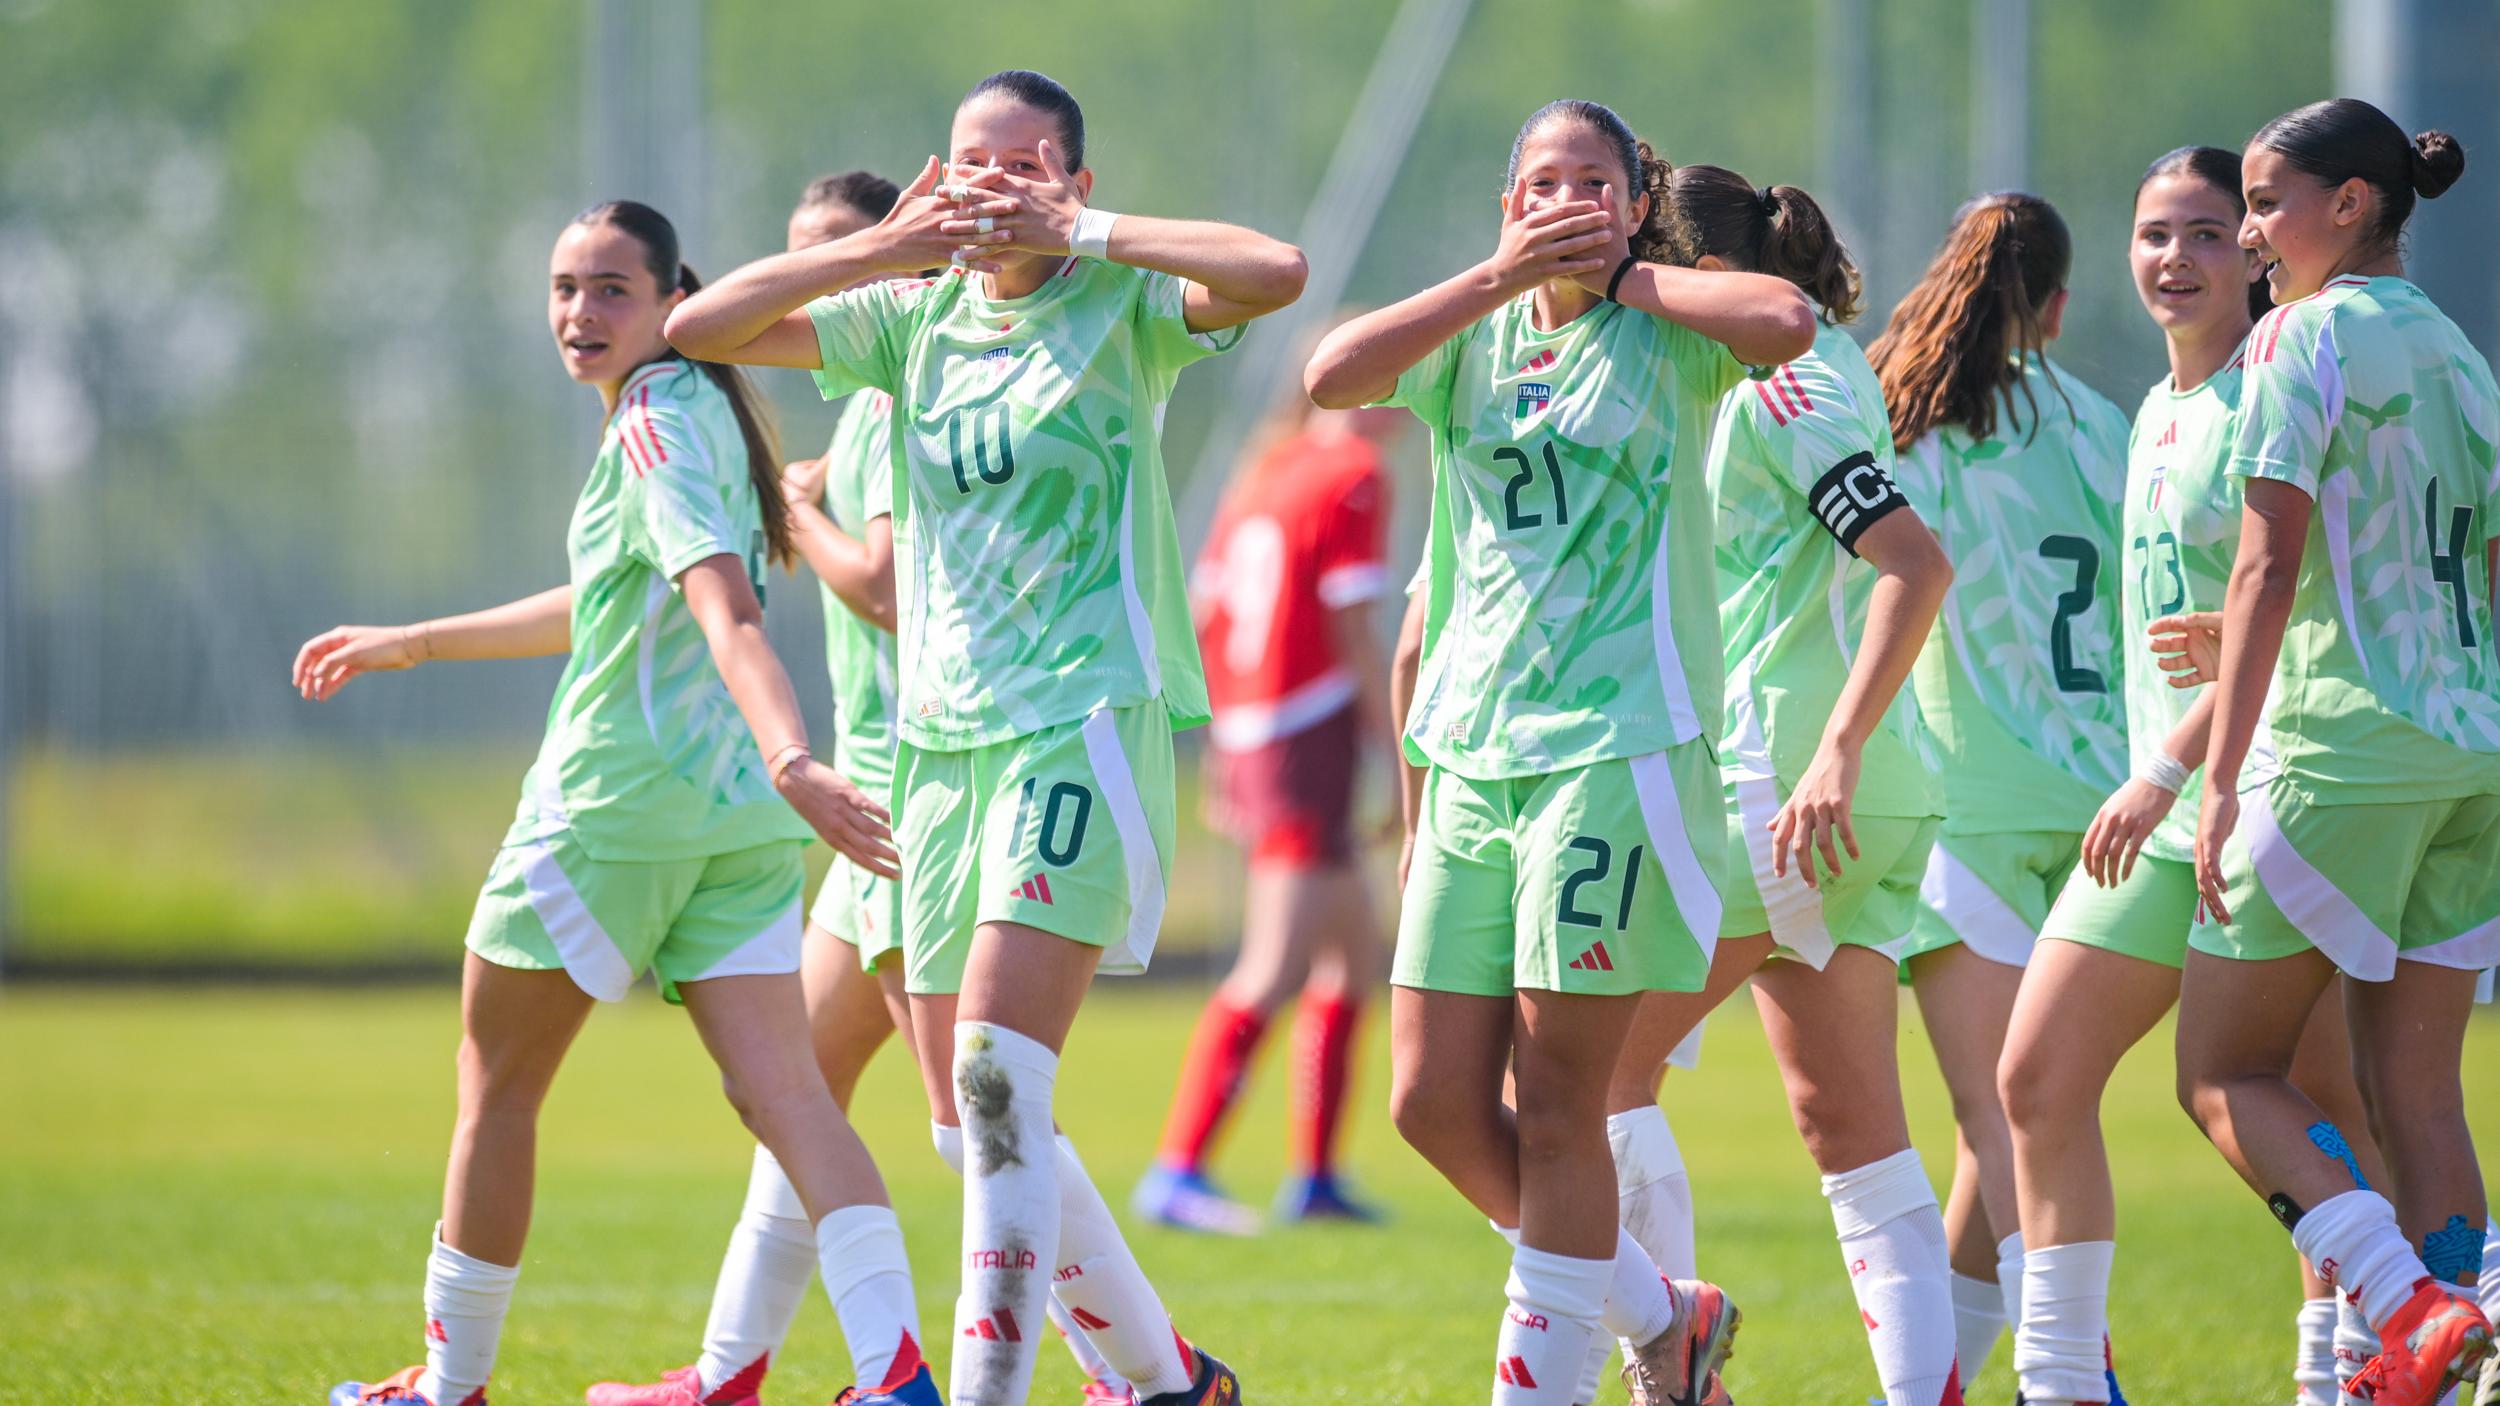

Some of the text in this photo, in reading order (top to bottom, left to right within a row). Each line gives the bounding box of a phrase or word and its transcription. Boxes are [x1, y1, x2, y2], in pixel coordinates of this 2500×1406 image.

[1518, 385, 1549, 397] ITALIA
[949, 400, 1015, 495] 10
[1493, 440, 1569, 531] 21
[1844, 465, 1889, 510] C
[2425, 475, 2477, 648] 4
[2039, 534, 2108, 694] 2
[1007, 776, 1093, 867] 10
[1557, 836, 1644, 930] 21
[1053, 1264, 1083, 1281] LIA
